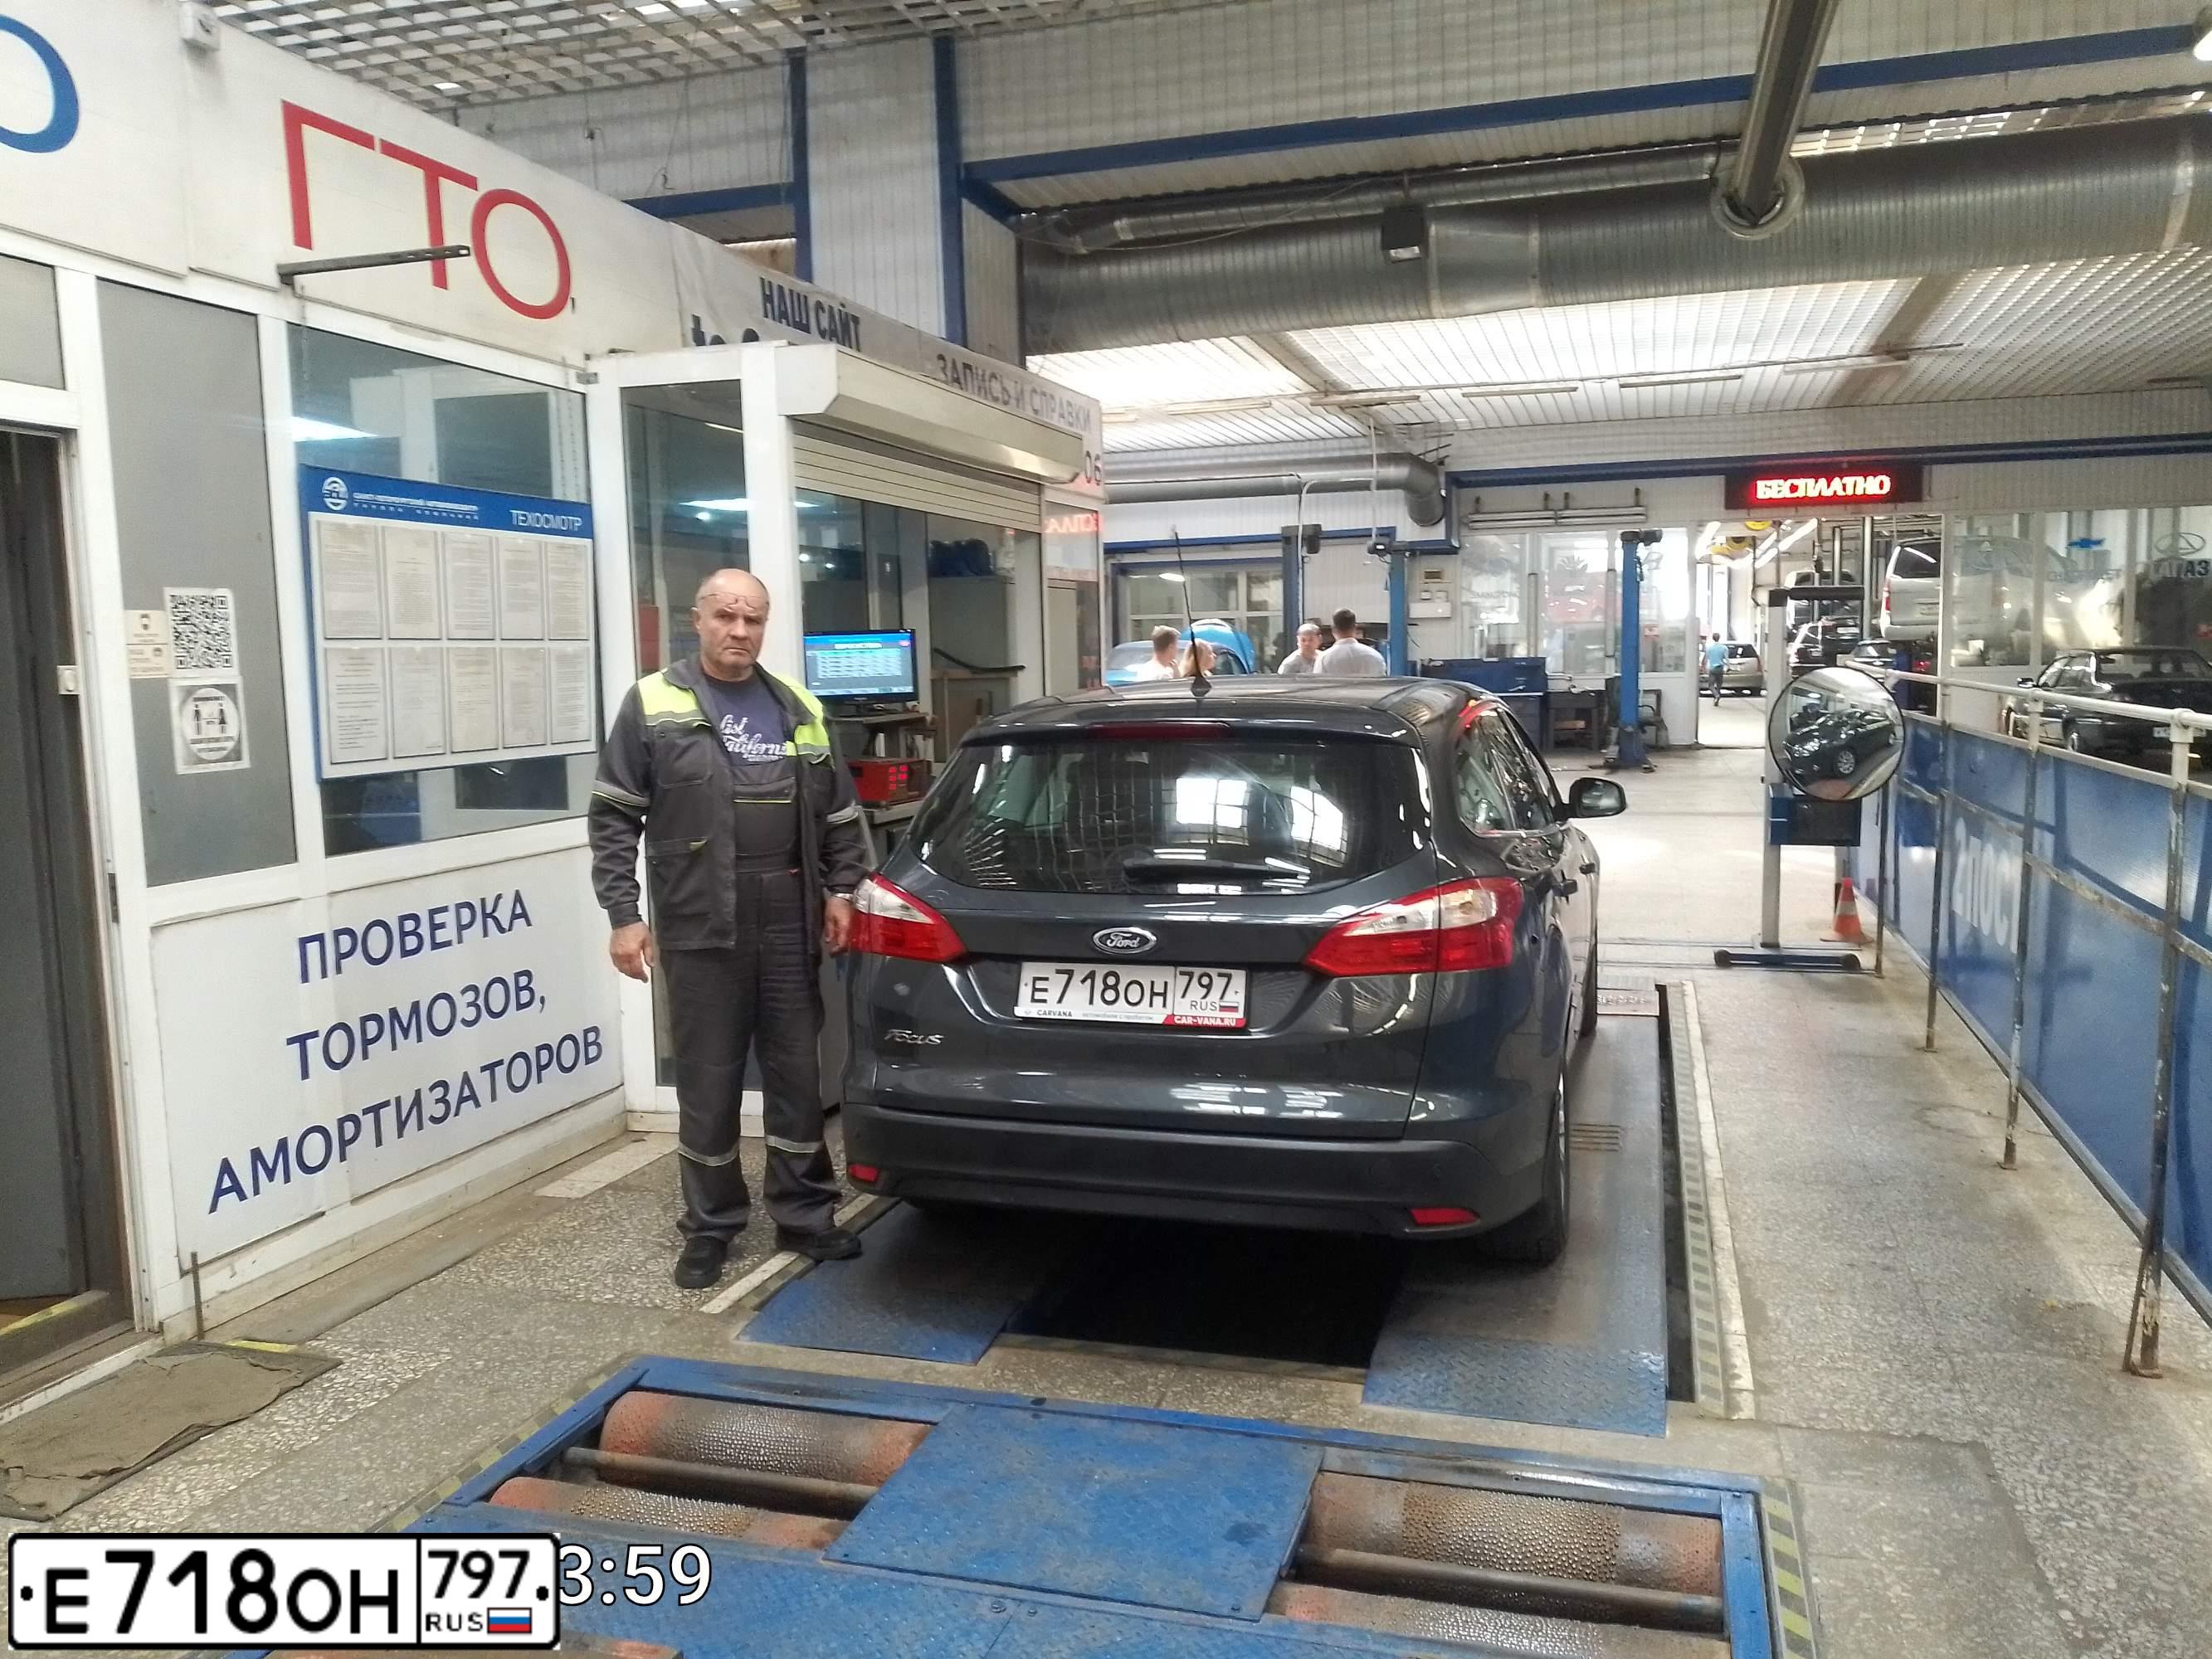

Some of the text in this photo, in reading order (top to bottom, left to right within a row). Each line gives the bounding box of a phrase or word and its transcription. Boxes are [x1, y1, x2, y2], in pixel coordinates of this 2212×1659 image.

[280, 100, 572, 320] ГТО
[759, 276, 811, 334] НАШ
[814, 298, 862, 353] САЙТ
[937, 353, 1011, 406] ЗАПИСЬ
[1030, 389, 1091, 434] СПРАВКИ
[1756, 474, 1892, 499] БЕСПЛАТНО
[509, 509, 582, 532] ТЕХОСМОТР
[298, 888, 533, 984] ПРОВЕРКА
[1106, 932, 1142, 949] Ford
[1030, 967, 1234, 1009] Е718ОН 797
[1190, 1000, 1218, 1012] RUS
[286, 969, 546, 1081] ТОРМОЗОВ,
[1037, 1009, 1073, 1018] CARVANA
[1173, 1015, 1236, 1027] CAR-VANA.RU
[208, 1025, 603, 1214] АМОРТИЗАТОРОВ
